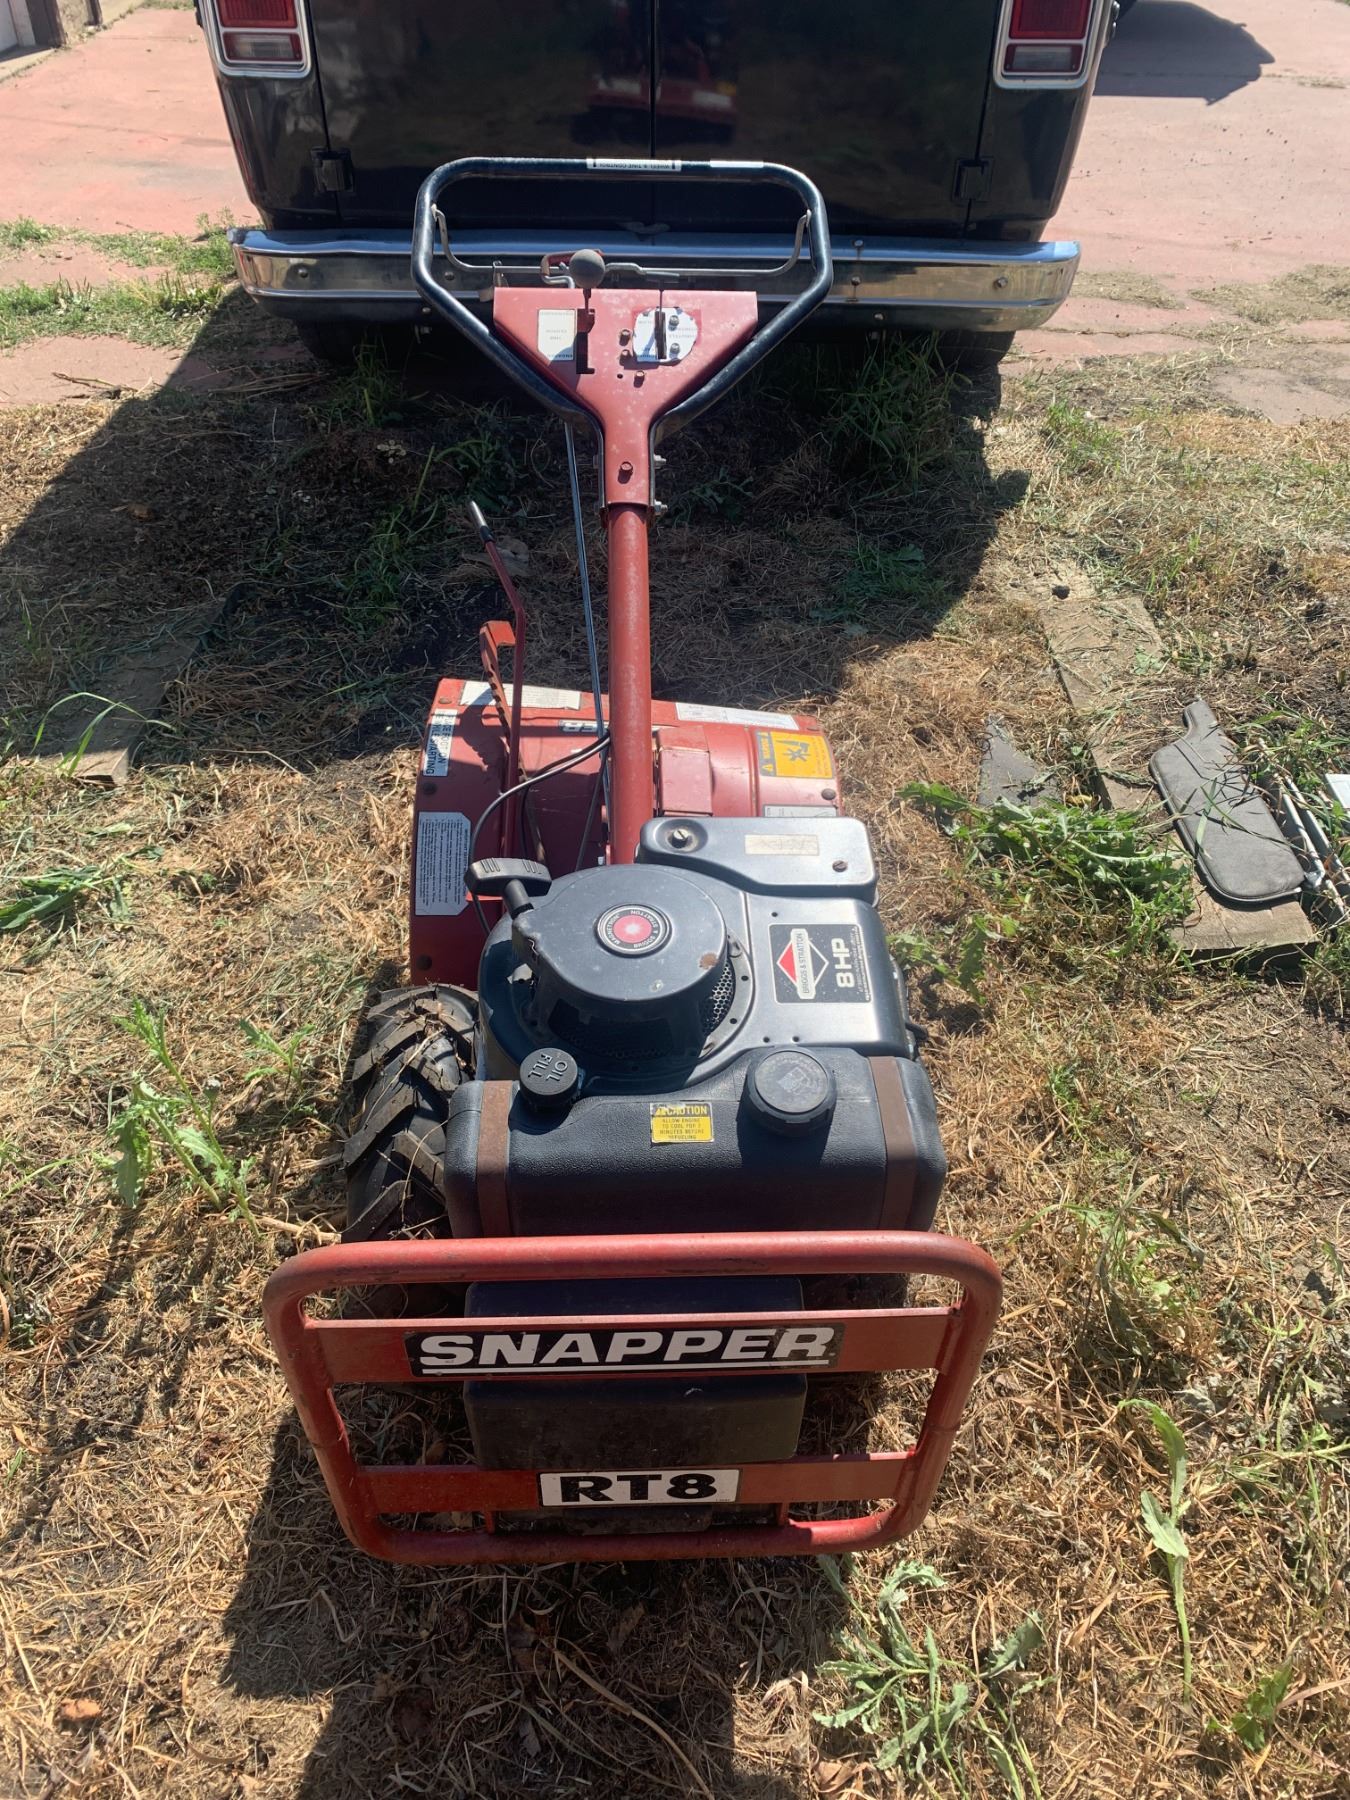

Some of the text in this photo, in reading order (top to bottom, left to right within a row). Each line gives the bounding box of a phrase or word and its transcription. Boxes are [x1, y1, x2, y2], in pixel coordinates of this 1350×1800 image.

[440, 732, 452, 750] FOOT
[426, 739, 439, 774] STARTING
[438, 752, 448, 763] ON
[795, 932, 806, 964] STRATTON
[831, 938, 855, 988] 8 HP
[800, 970, 810, 994] BRIGGS
[528, 1053, 552, 1078] FILL
[546, 1061, 568, 1082] OIL
[667, 1105, 708, 1116] CAUTION
[420, 1326, 835, 1366] SNAPPER
[559, 1472, 718, 1503] RT8
